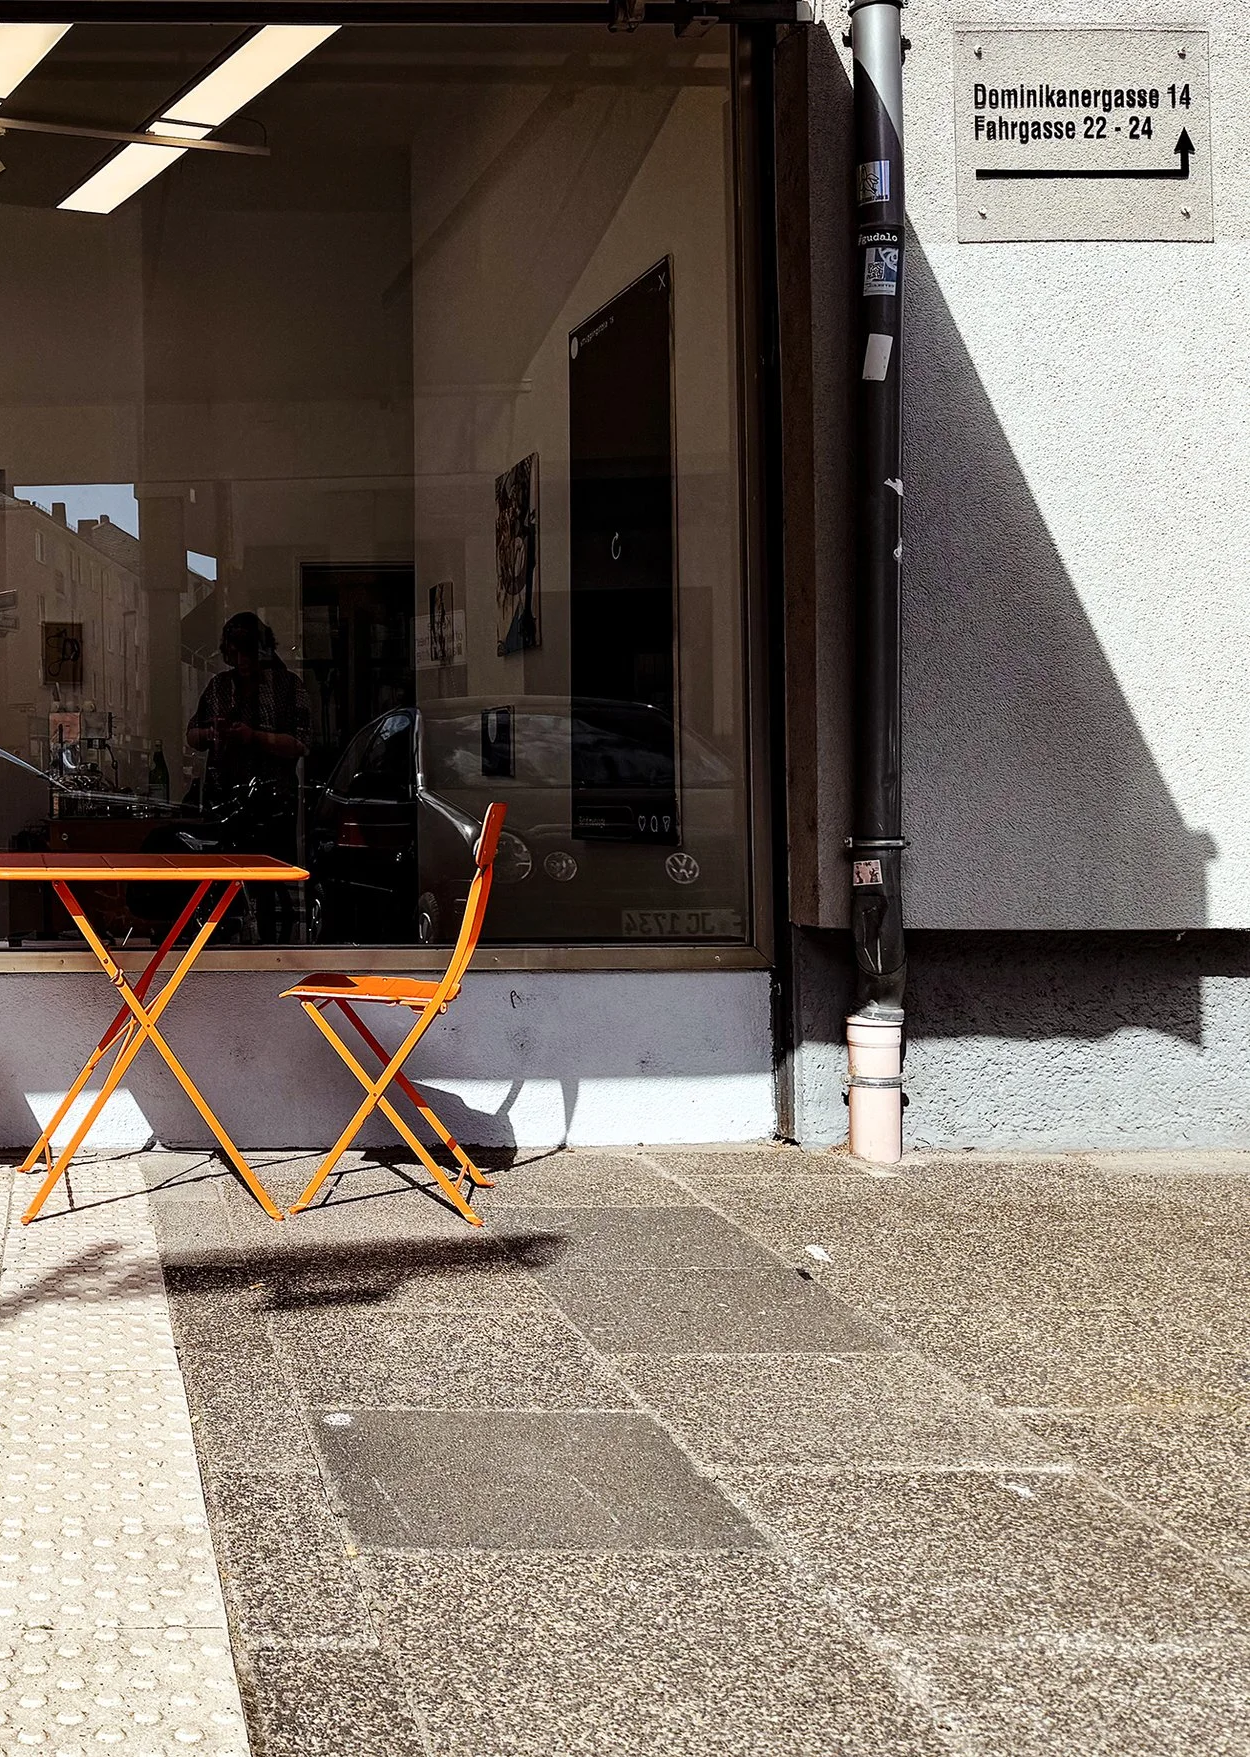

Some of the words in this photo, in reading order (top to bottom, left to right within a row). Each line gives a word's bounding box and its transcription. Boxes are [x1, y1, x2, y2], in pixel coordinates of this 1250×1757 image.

[973, 83, 1160, 113] Dominikanergasse
[1166, 83, 1192, 109] 14
[974, 115, 1076, 145] Fahrgasse
[1083, 115, 1107, 140] 22
[1128, 115, 1153, 140] 24
